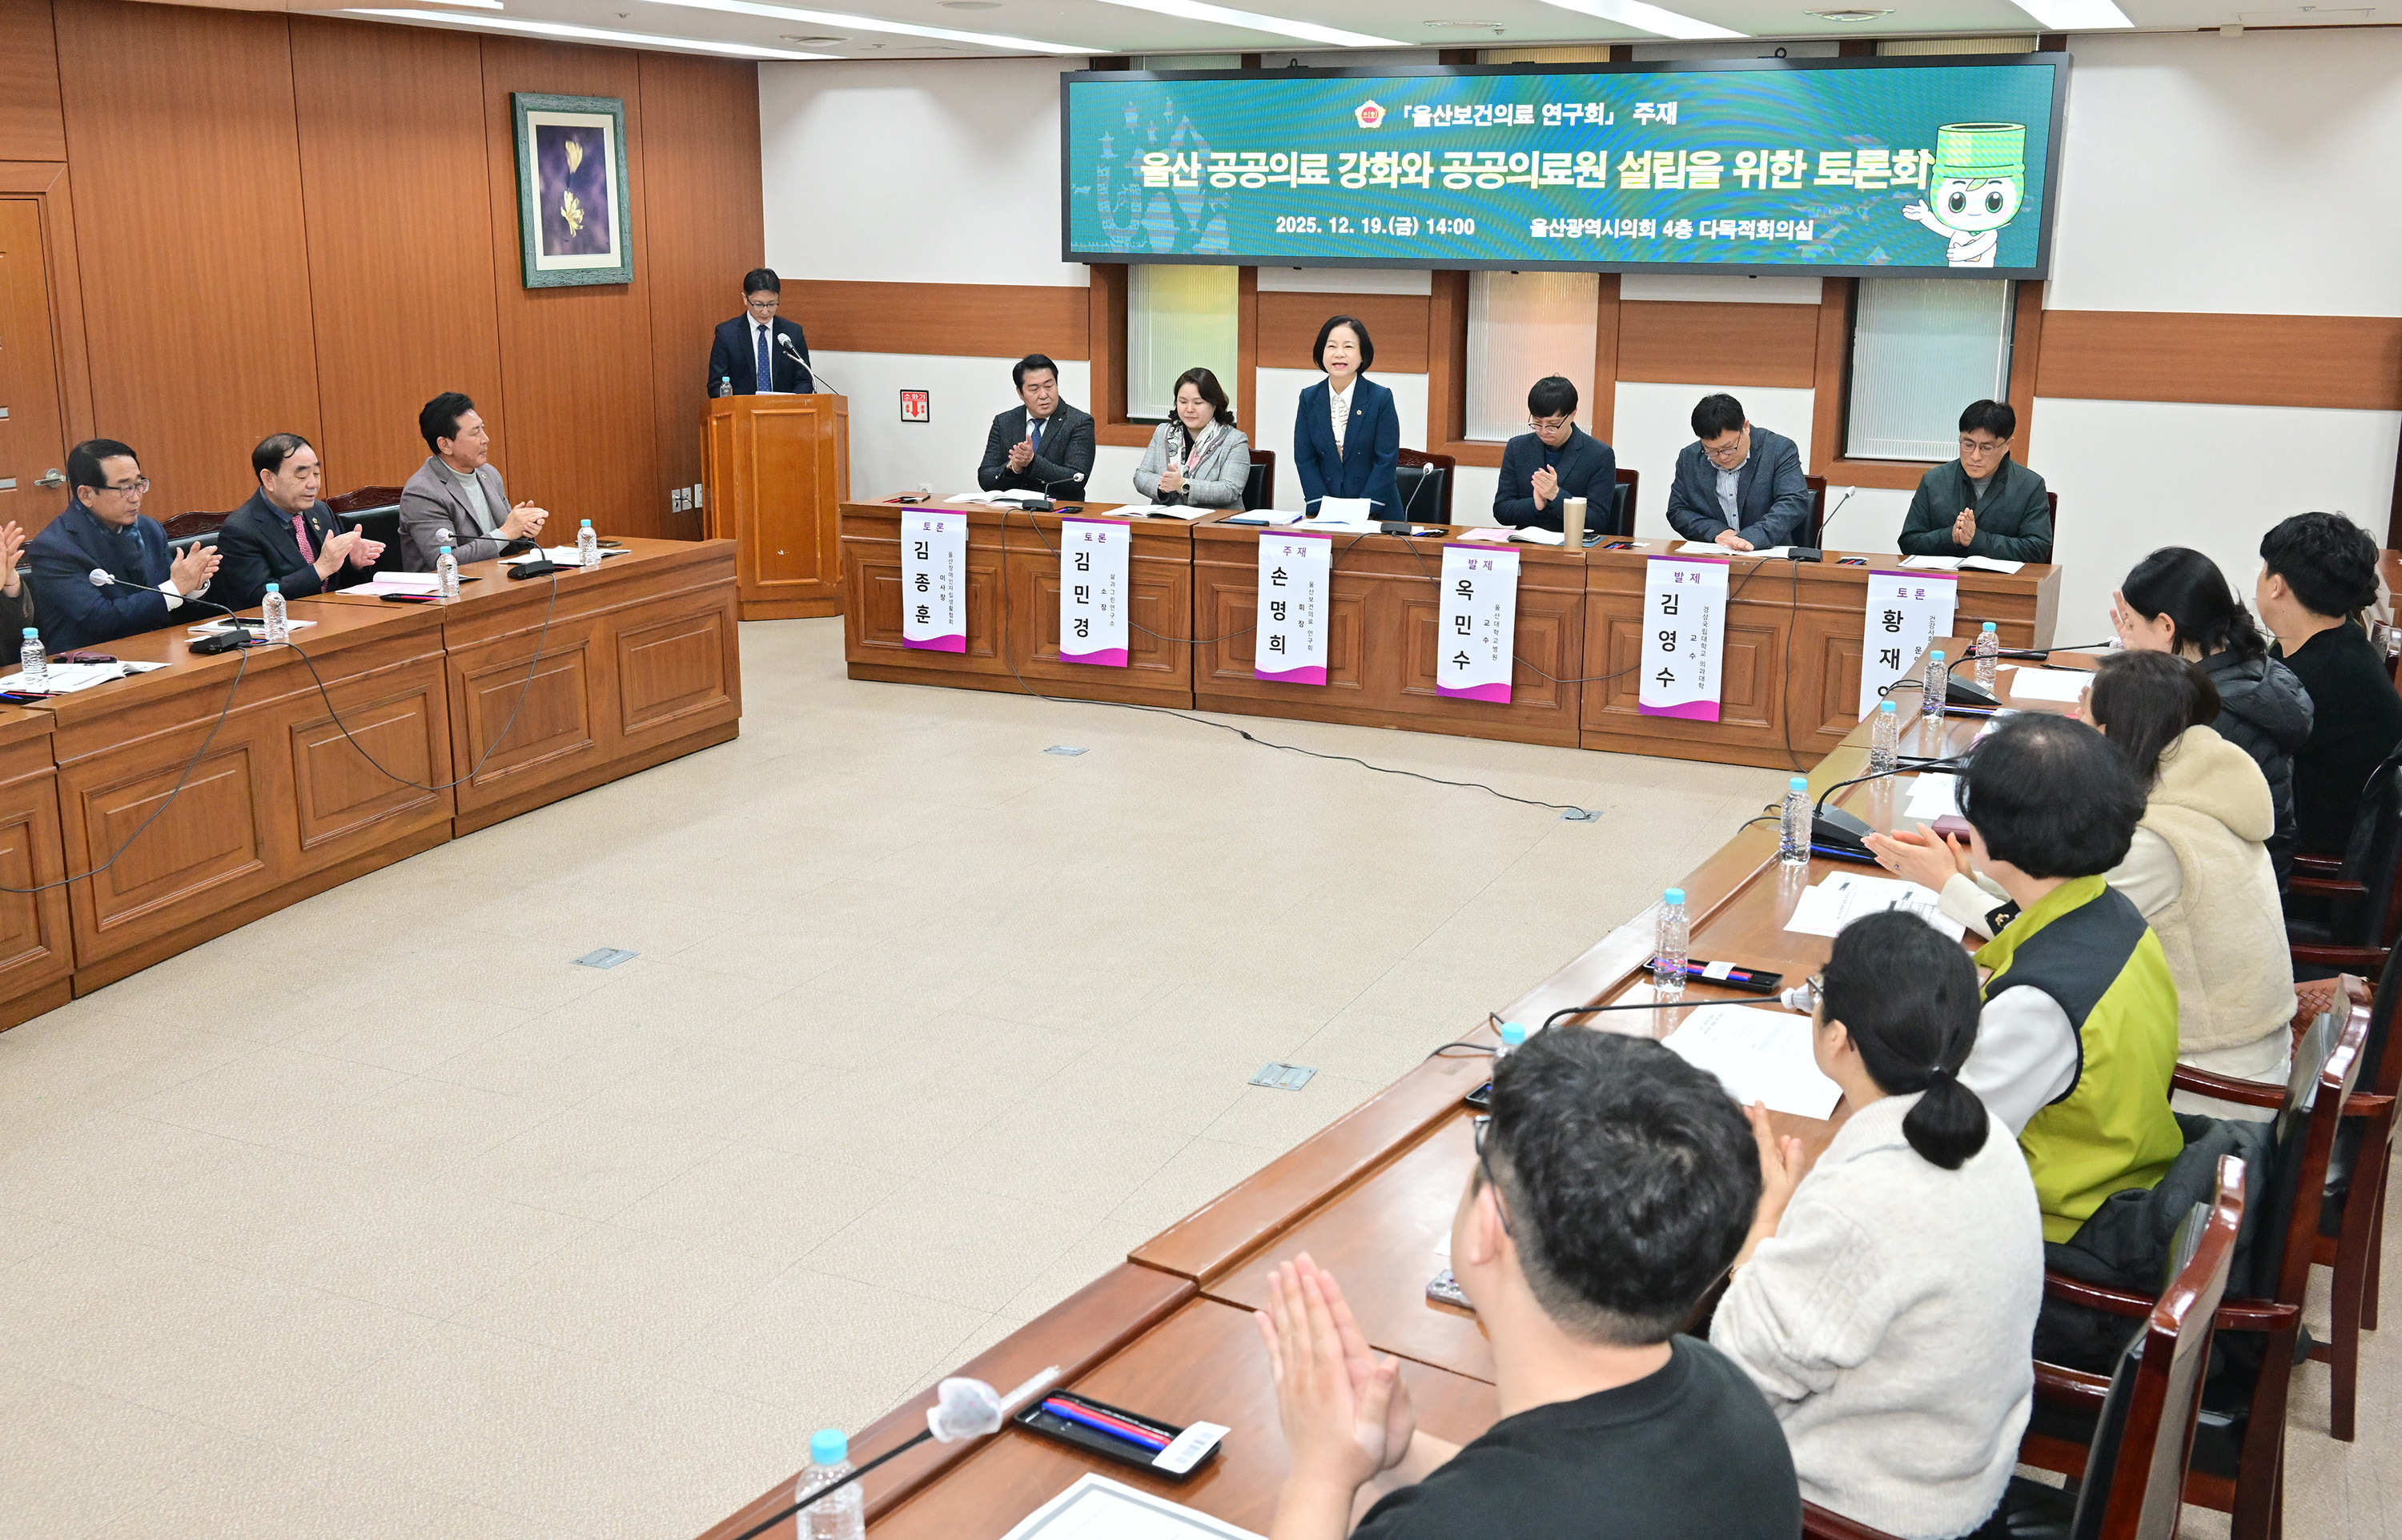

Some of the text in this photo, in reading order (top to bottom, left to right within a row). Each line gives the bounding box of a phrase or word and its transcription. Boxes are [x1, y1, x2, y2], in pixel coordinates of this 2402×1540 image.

[1633, 102, 1677, 126] 주재
[1140, 148, 1930, 190] 울산 공공의료 강화와 공공의료원 설립을 위한 토론회
[1275, 216, 1475, 236] 2025. 12. 19.(금) 14:00
[1529, 219, 1814, 241] 울산광역시의회 4층 다목적회의실
[1492, 604, 1500, 661] 울산대학교병원
[1700, 606, 1709, 657] 경상국립대학교
